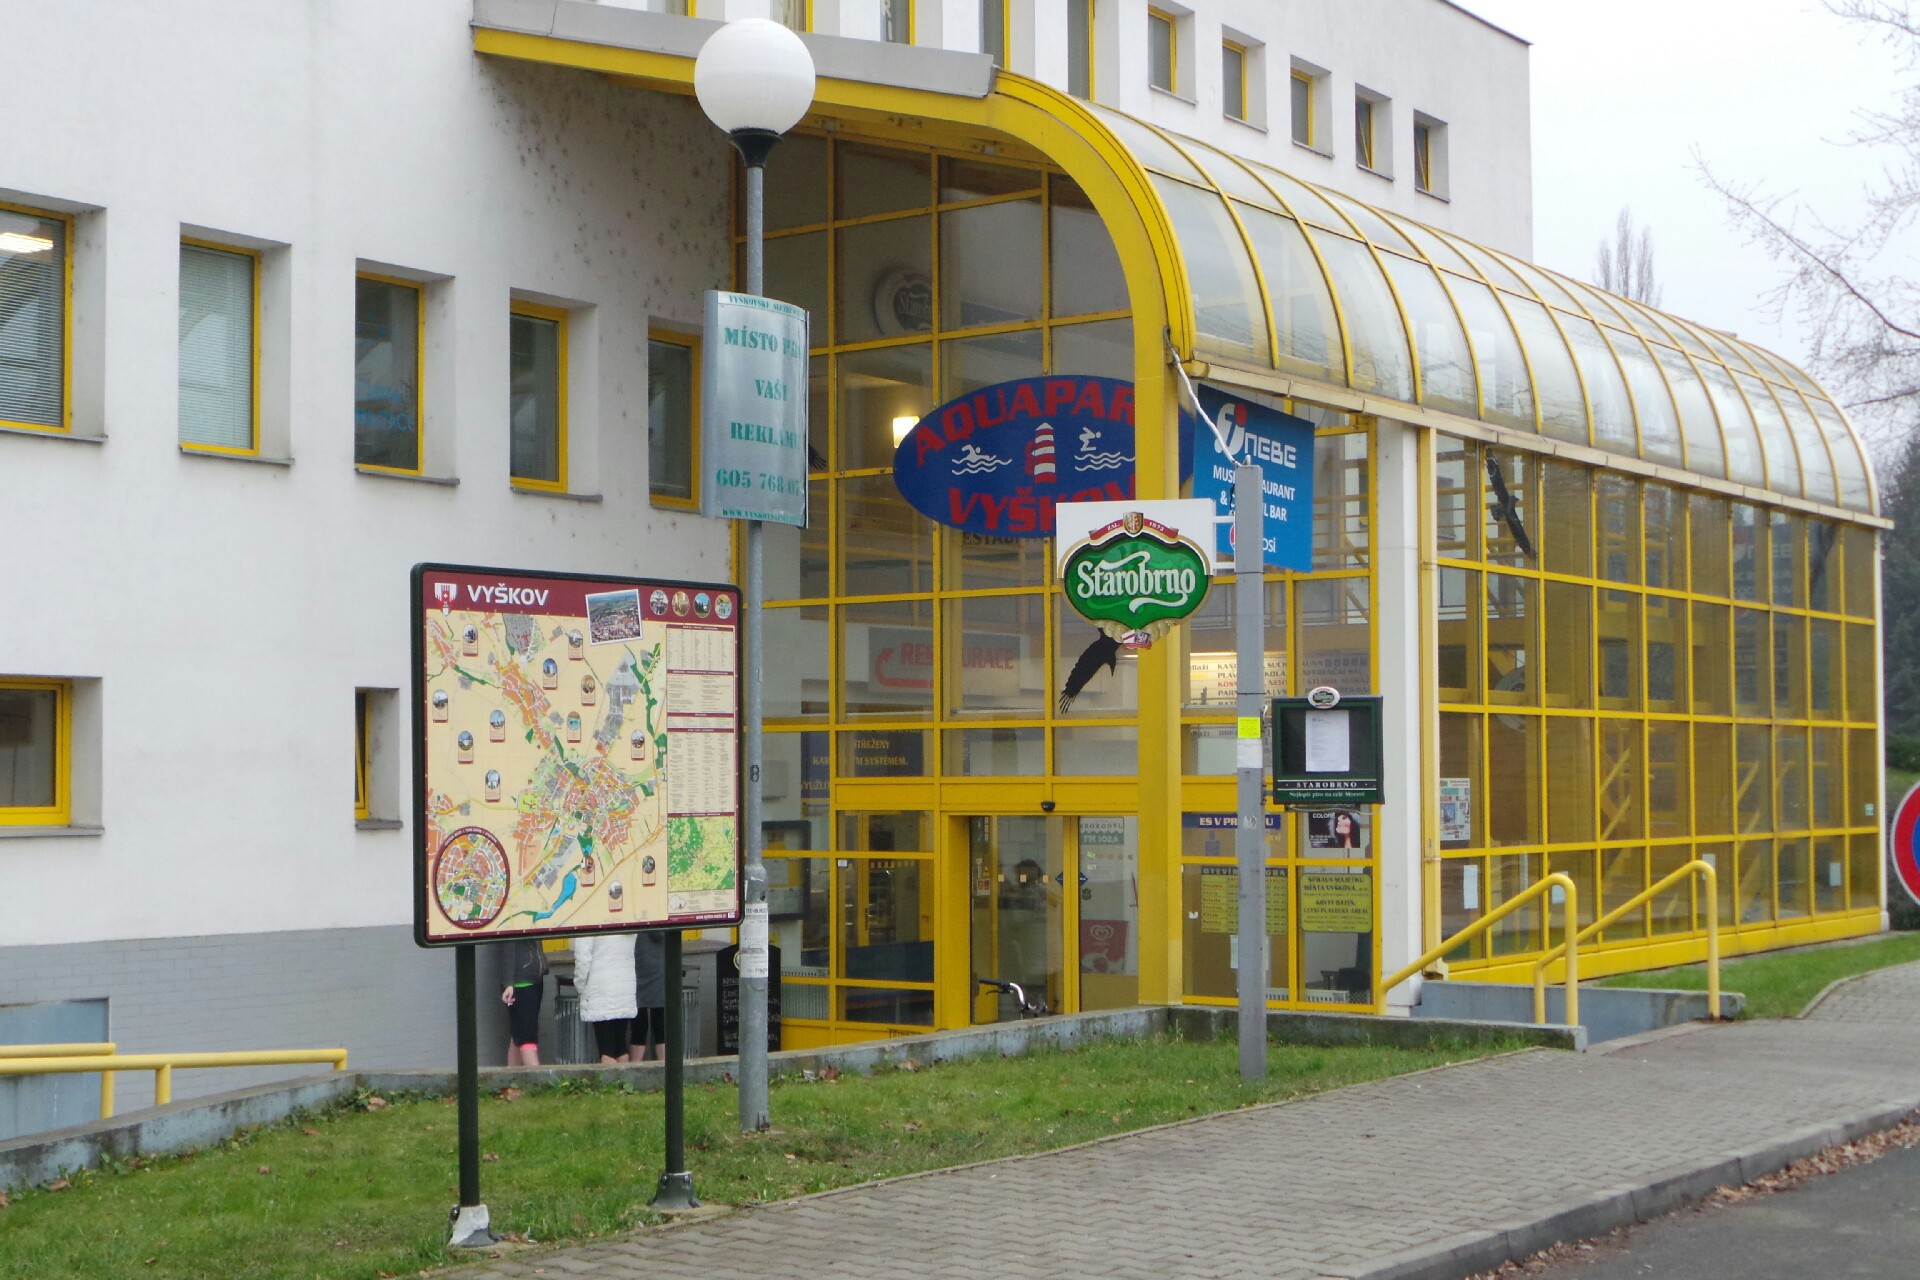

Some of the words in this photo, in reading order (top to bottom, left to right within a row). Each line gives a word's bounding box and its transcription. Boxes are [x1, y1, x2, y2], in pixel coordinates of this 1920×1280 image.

[724, 325, 778, 352] MÍSTO
[755, 378, 787, 401] VAŠI
[914, 380, 1135, 468] AQUAPAR
[716, 468, 752, 489] 605
[759, 473, 784, 493] 768
[1220, 490, 1228, 506] &
[1269, 505, 1287, 521] BAR
[467, 583, 549, 606] VYŠKOV
[1077, 551, 1196, 613] Starobrno
[1296, 781, 1357, 789] STAROBRNO
